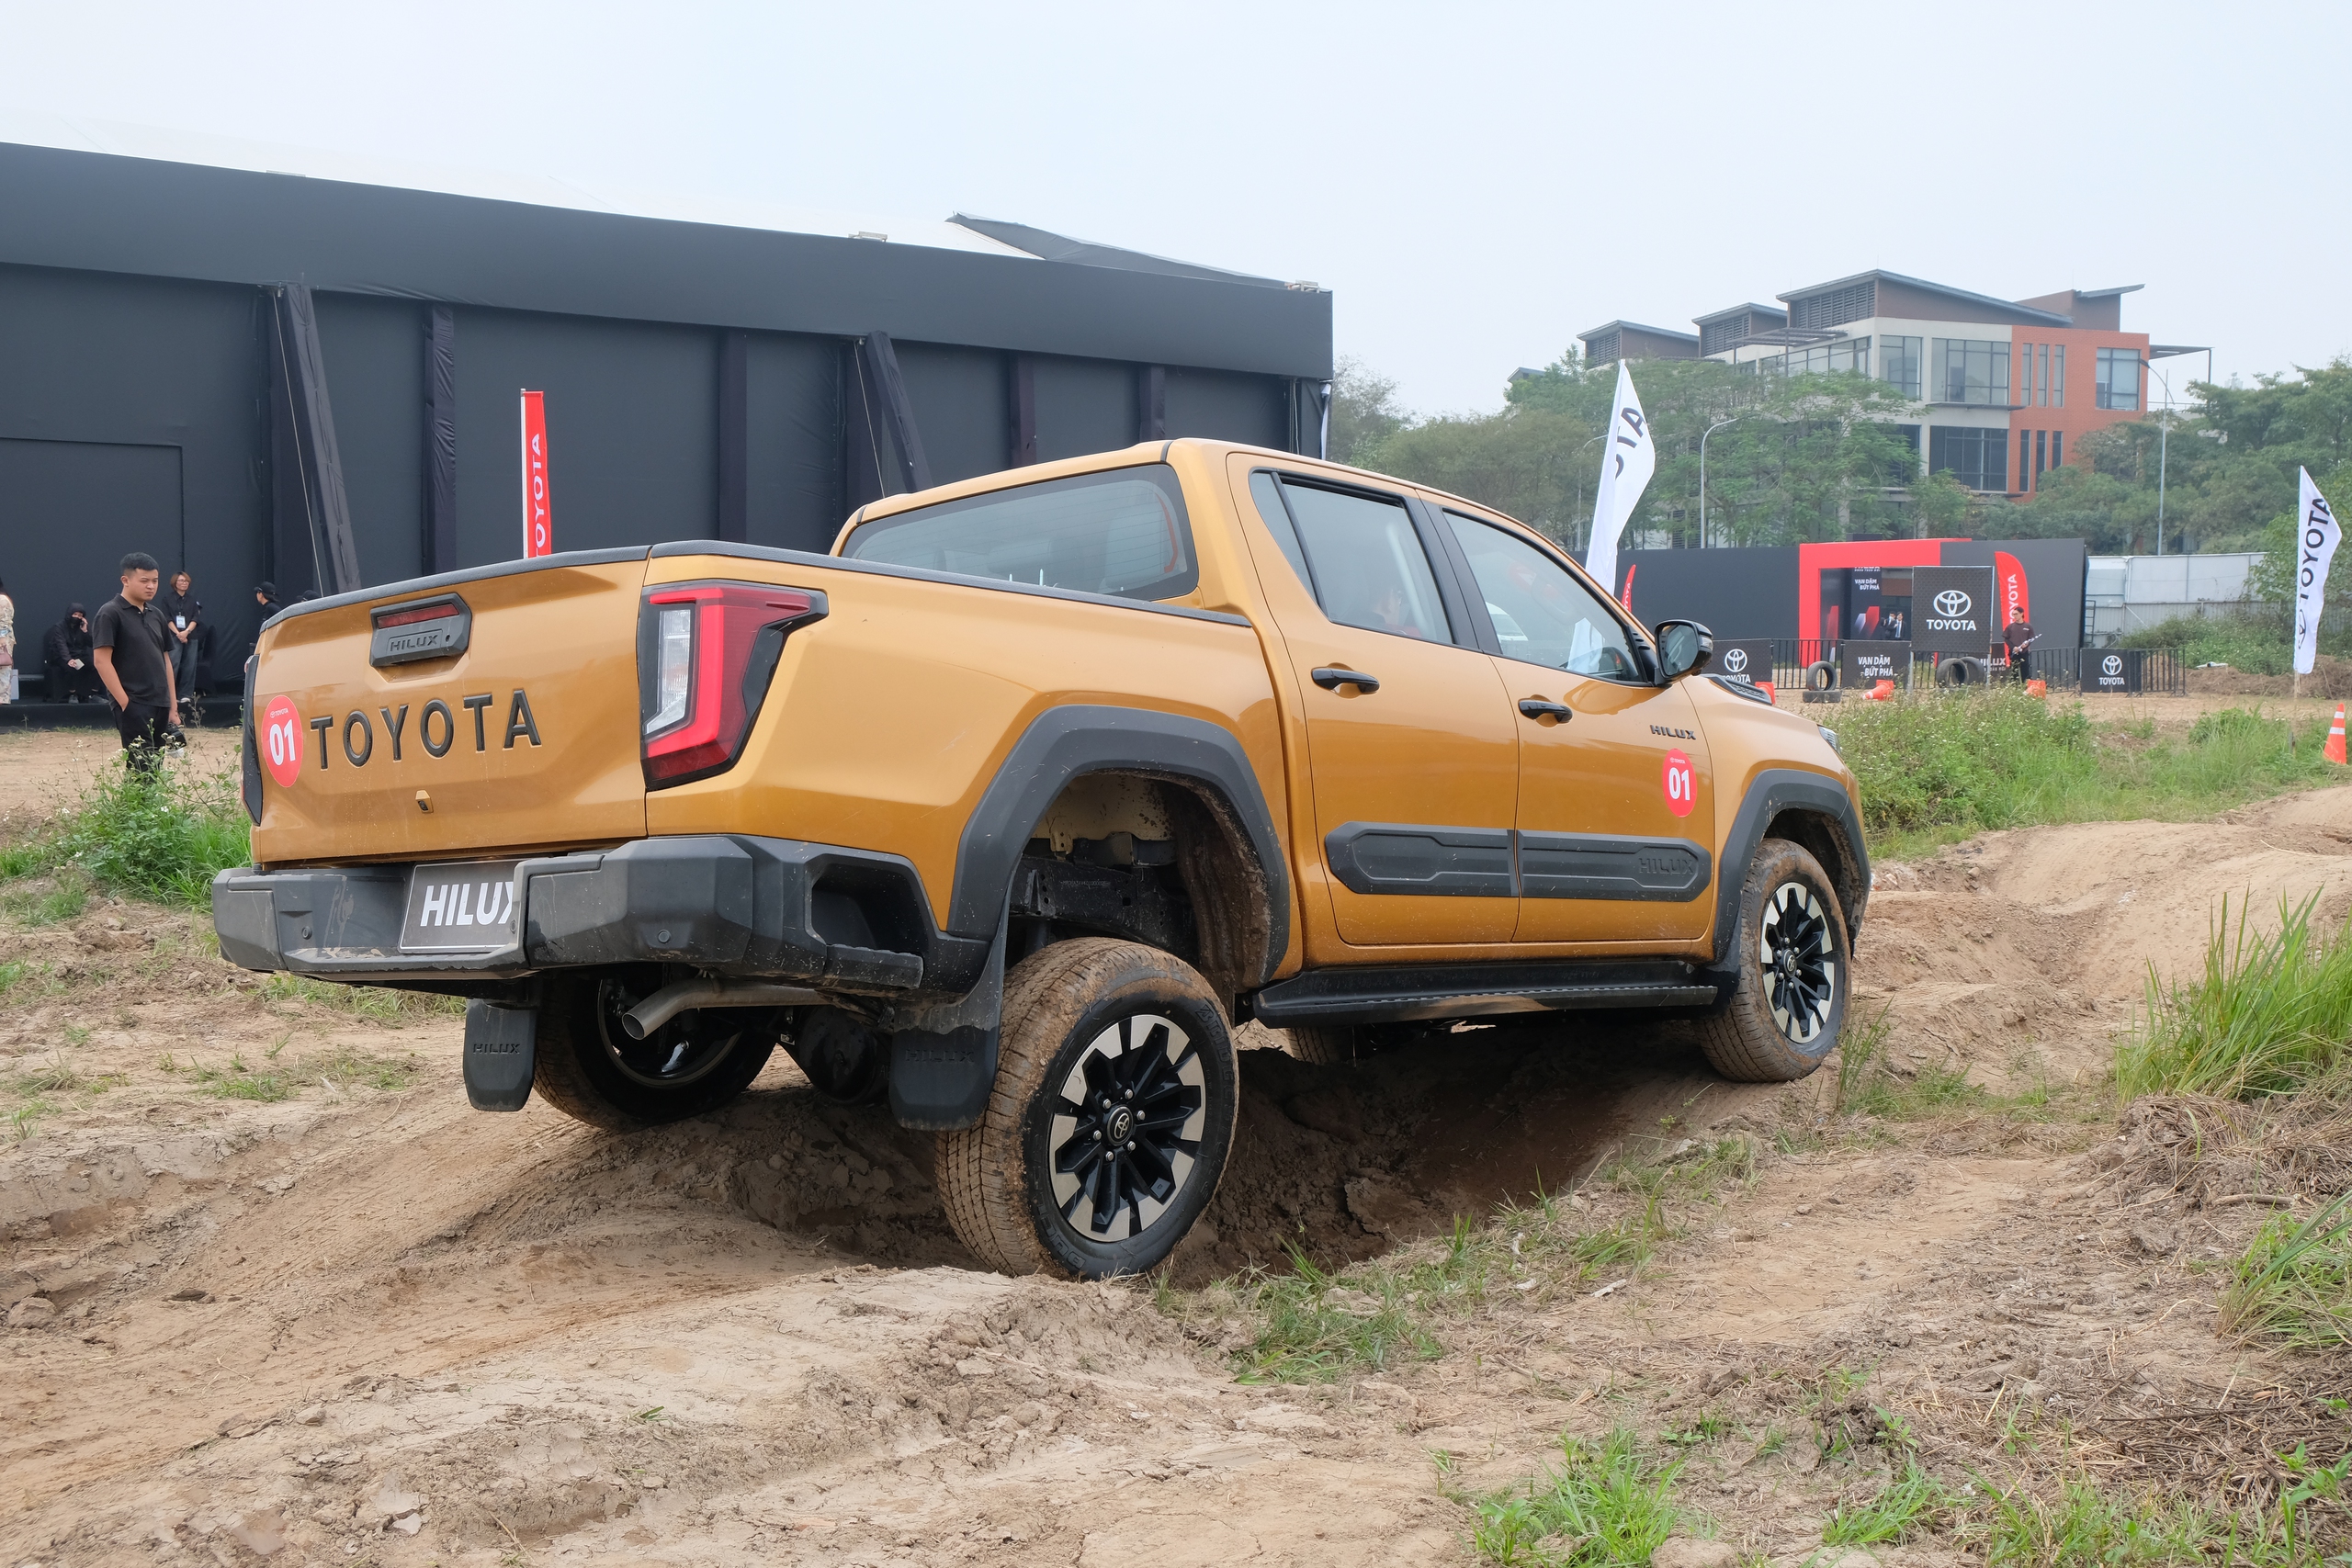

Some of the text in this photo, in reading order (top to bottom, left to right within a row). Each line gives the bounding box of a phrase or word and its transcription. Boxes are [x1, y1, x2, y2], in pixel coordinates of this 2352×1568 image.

[1926, 619, 1977, 630] TOYOTA
[390, 635, 439, 651] HILUX
[1858, 656, 1873, 668] VẠN
[1864, 666, 1894, 676] BỨT PHÁ
[2098, 677, 2125, 685] TOYOTA
[311, 689, 542, 771] TOYOTA
[1649, 724, 1697, 740] HILUX
[269, 718, 296, 766] 01
[1668, 767, 1690, 801] 01
[1639, 857, 1694, 874] HILUX
[473, 1043, 520, 1055] HILUX
